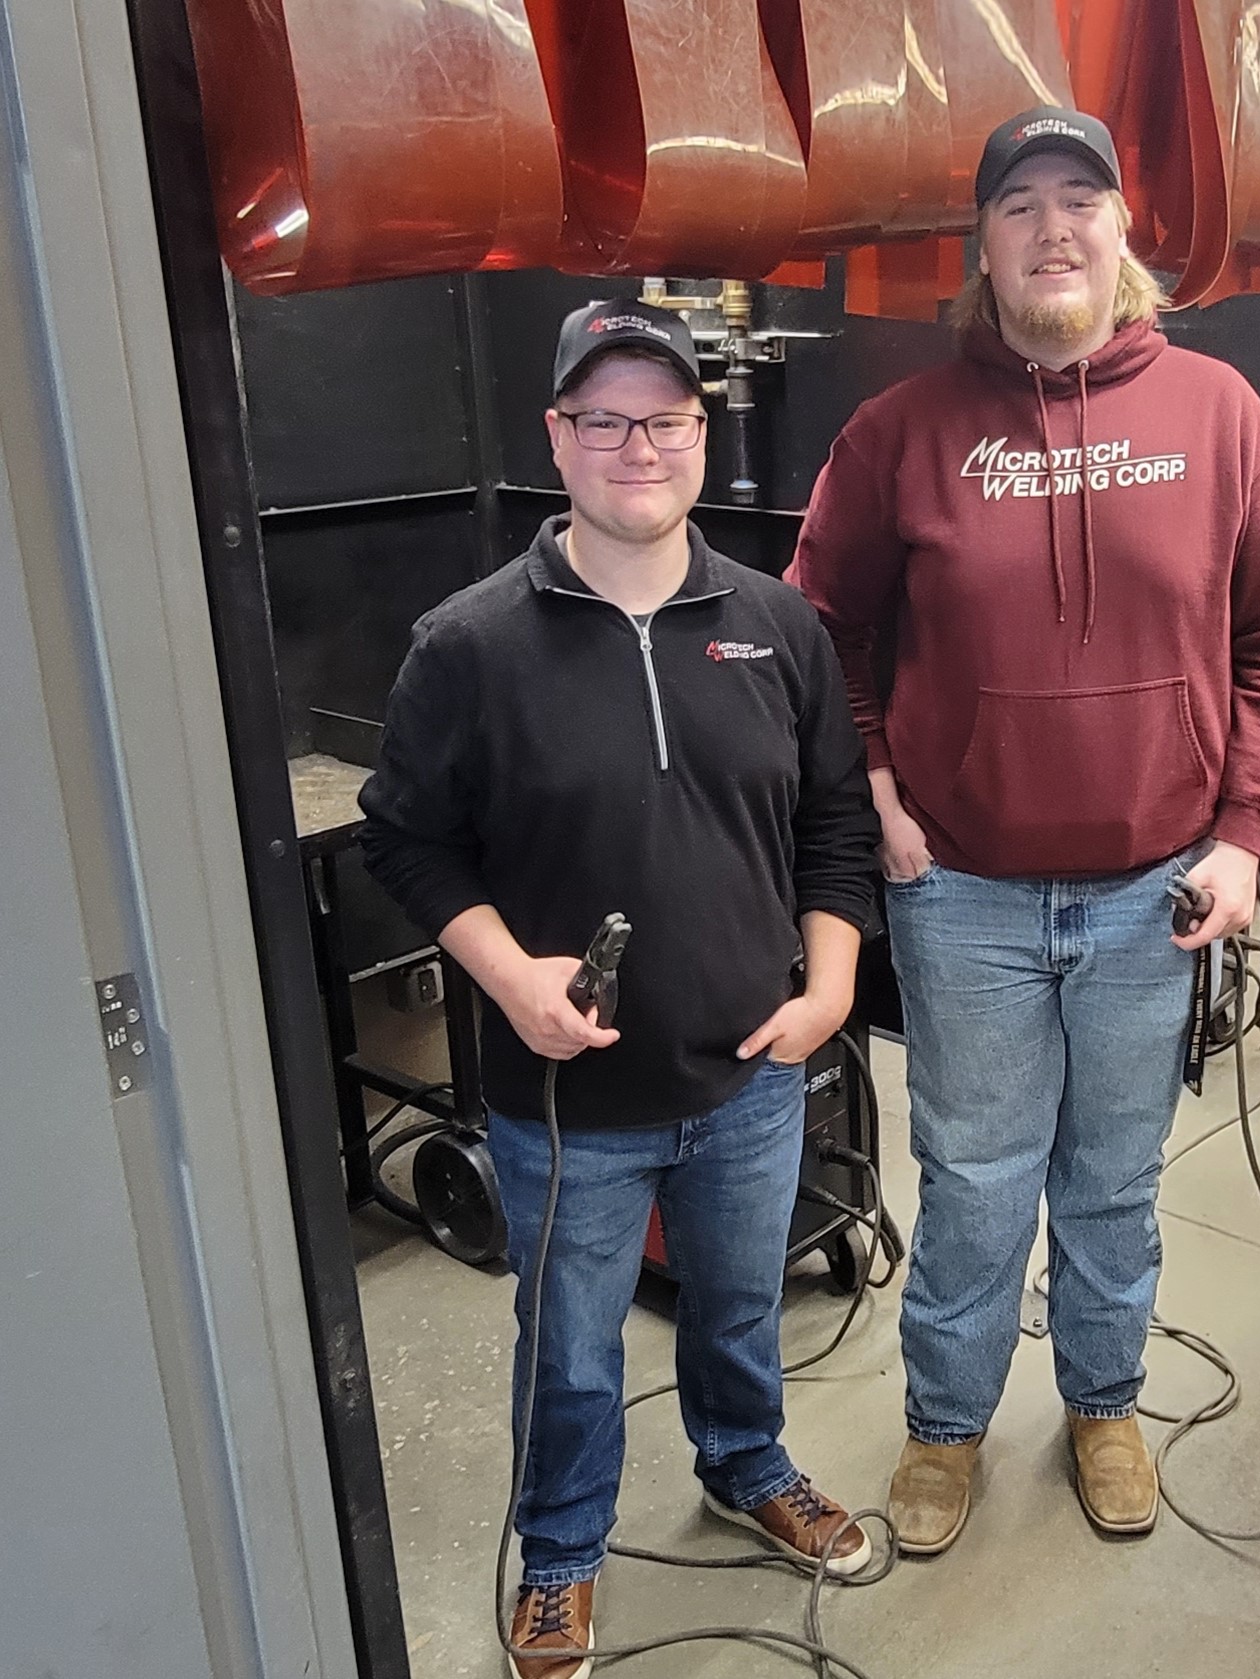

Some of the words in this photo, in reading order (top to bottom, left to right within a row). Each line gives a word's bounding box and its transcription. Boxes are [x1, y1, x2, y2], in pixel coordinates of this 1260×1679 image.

[961, 436, 1131, 477] MICROTECH
[983, 469, 1110, 501] WELDING
[1116, 458, 1186, 487] CORP.
